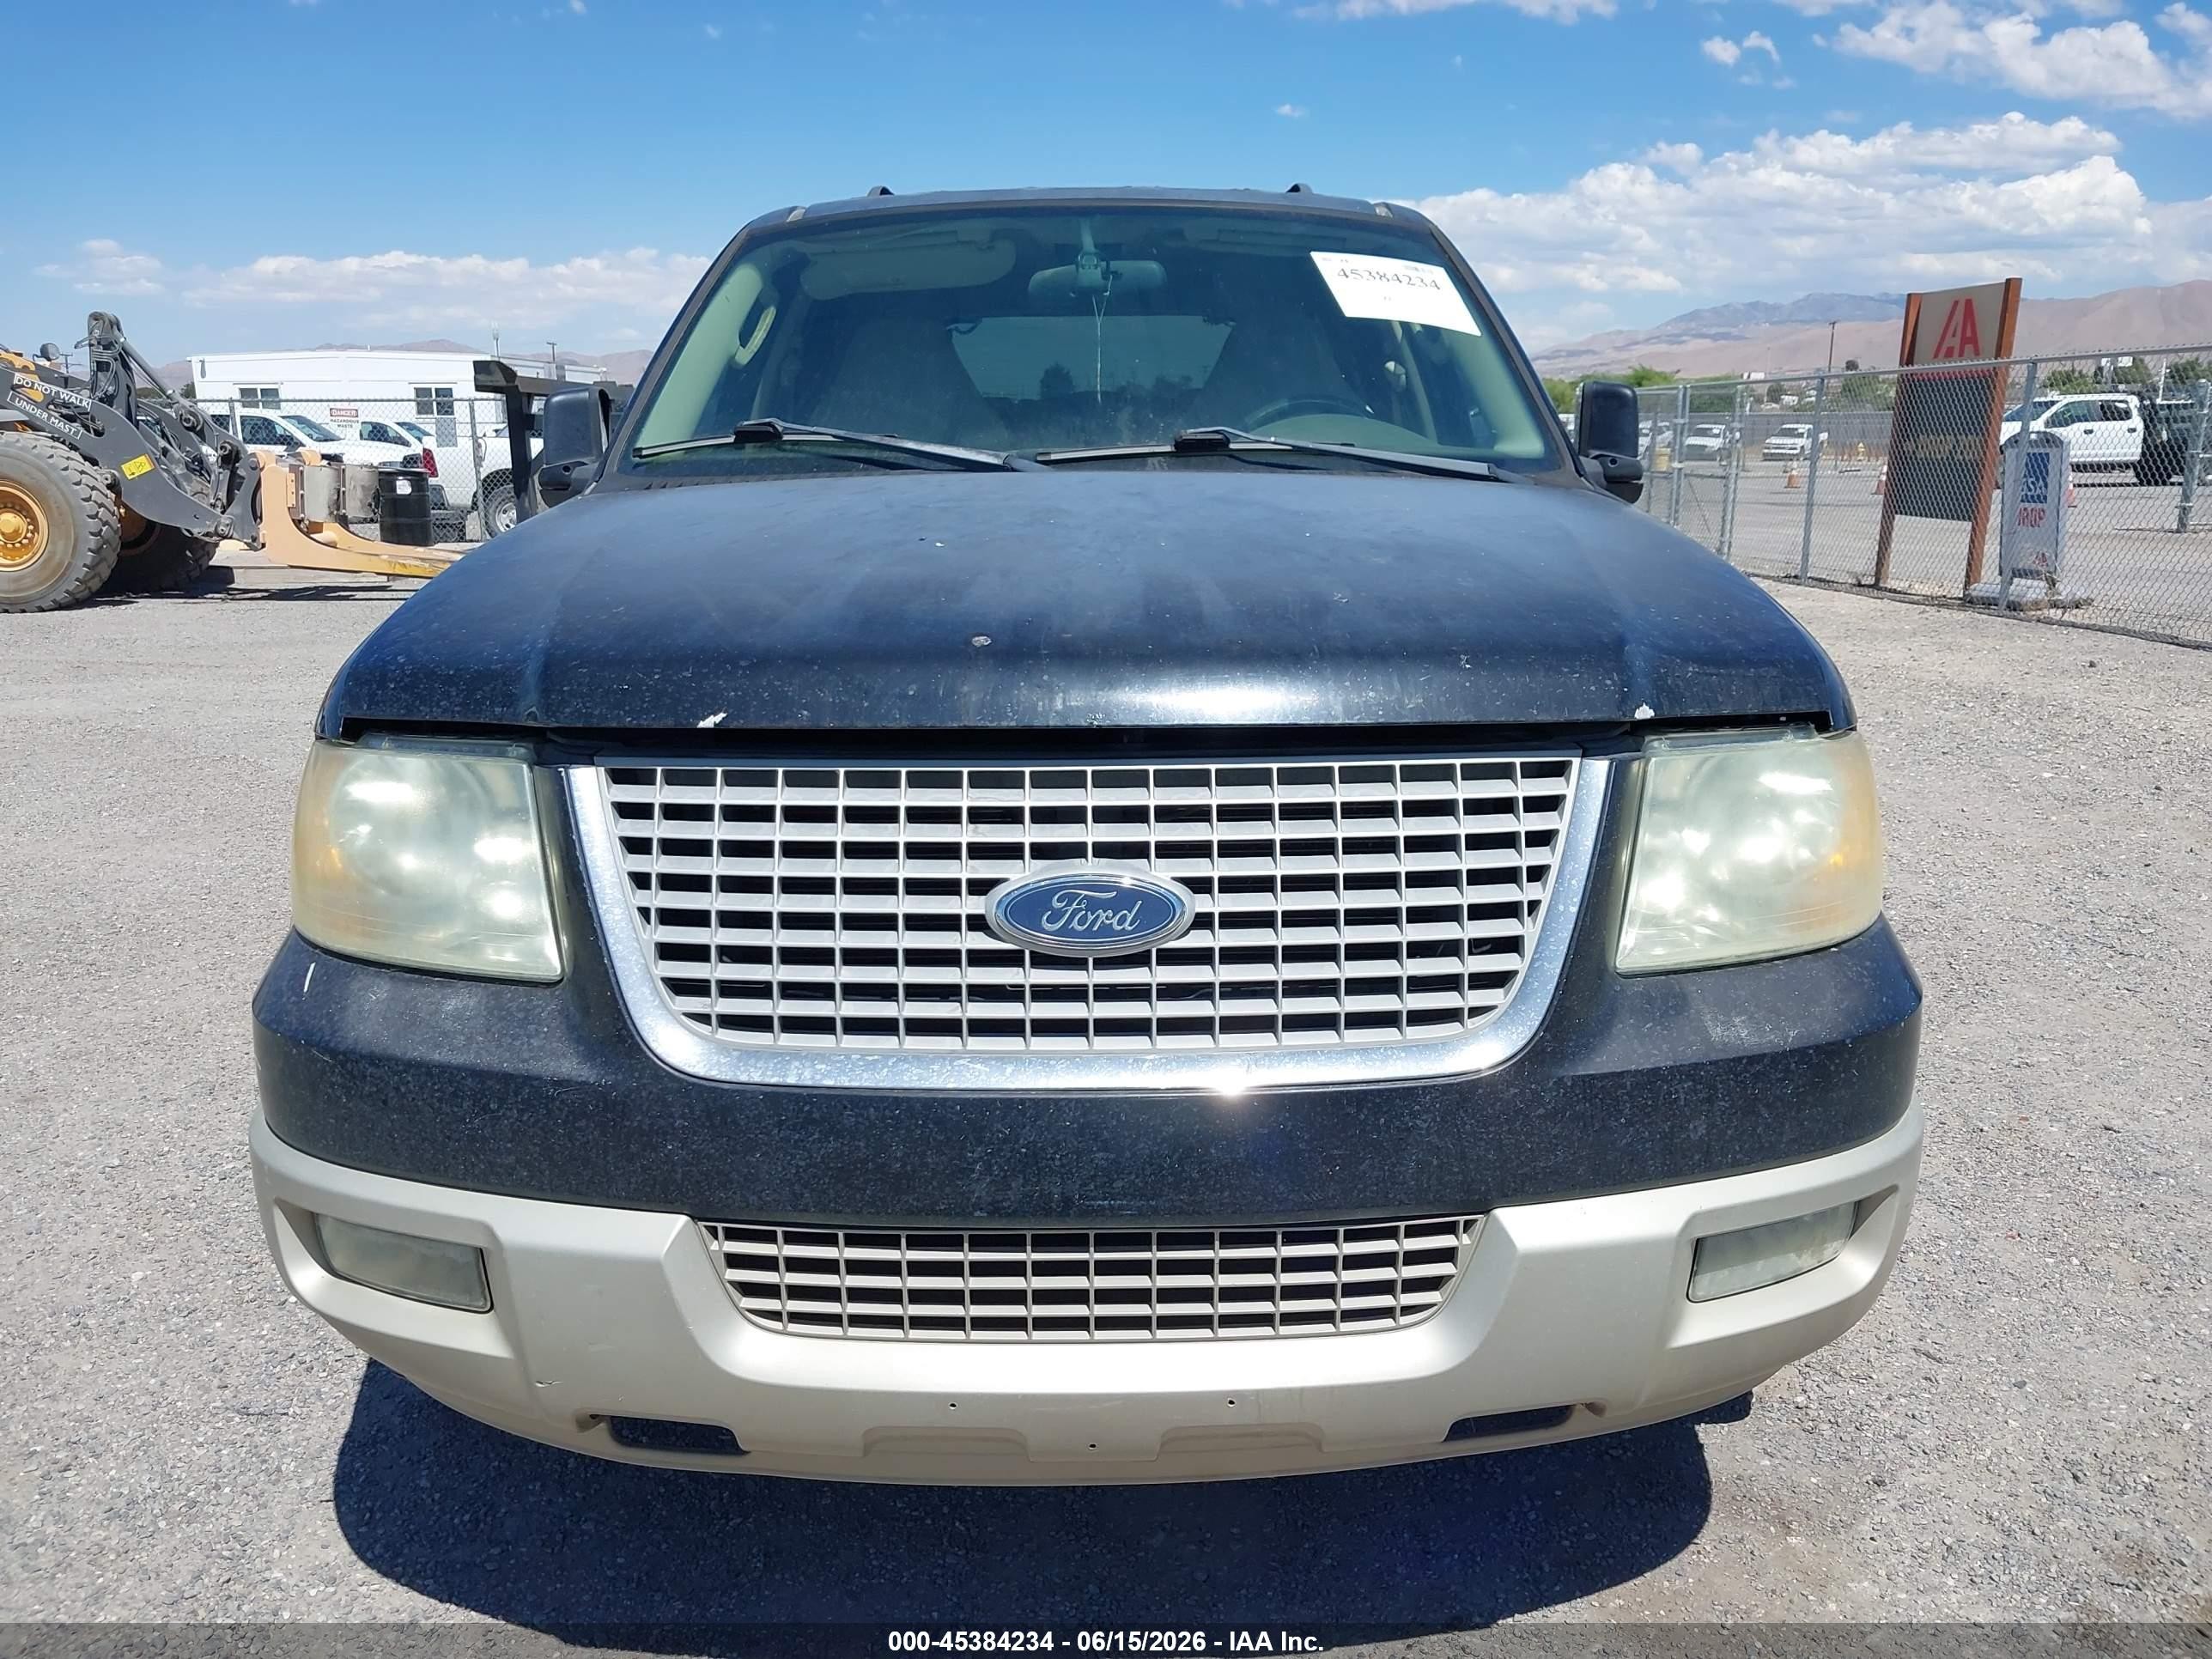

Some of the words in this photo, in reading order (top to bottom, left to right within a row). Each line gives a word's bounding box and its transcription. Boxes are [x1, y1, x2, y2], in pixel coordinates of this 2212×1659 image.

[1337, 268, 1441, 291] 45384234
[15, 376, 32, 387] DO
[33, 383, 57, 397] NOT
[59, 392, 88, 408] WALK
[15, 398, 48, 421] UNDER
[49, 416, 77, 434] MAST
[1042, 889, 1143, 932] Ford
